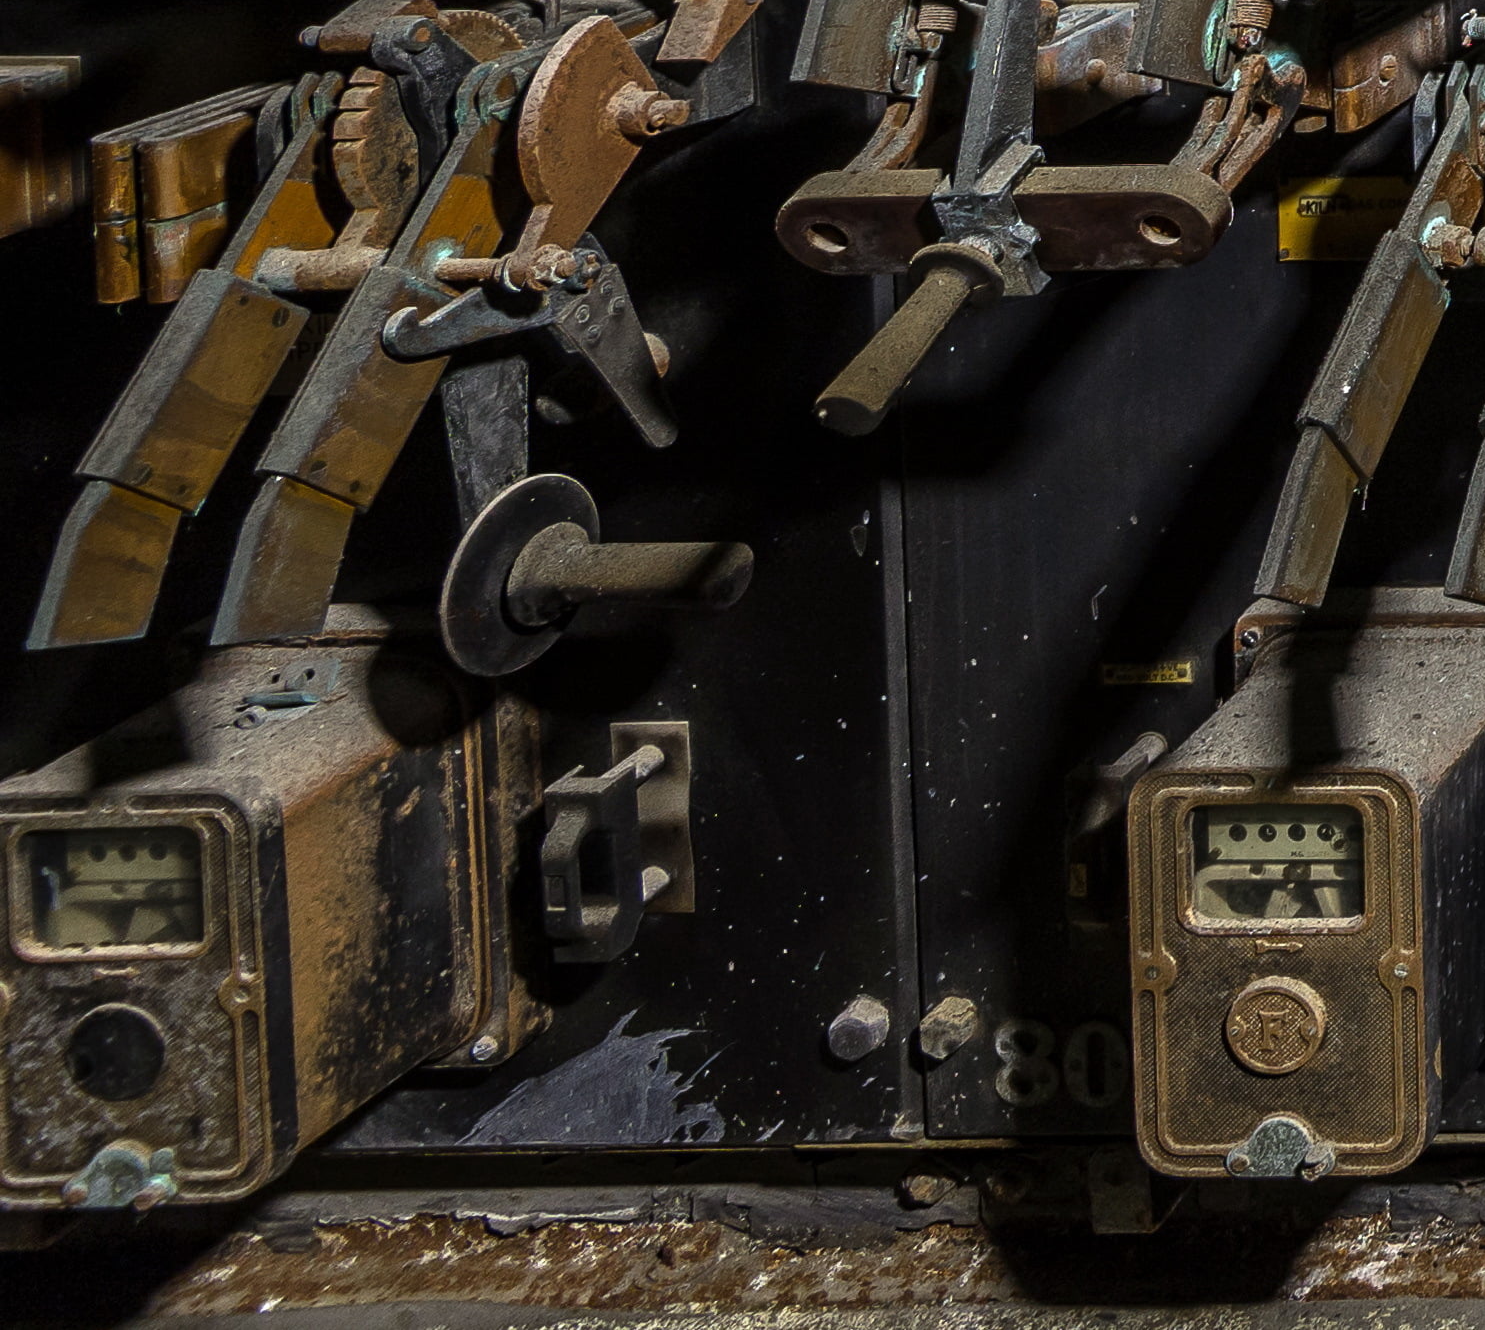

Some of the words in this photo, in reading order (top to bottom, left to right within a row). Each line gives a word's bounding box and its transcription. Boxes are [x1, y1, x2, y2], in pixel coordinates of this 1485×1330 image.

[1306, 201, 1338, 215] KILN
[1260, 1009, 1288, 1054] F
[996, 1018, 1128, 1109] 80
